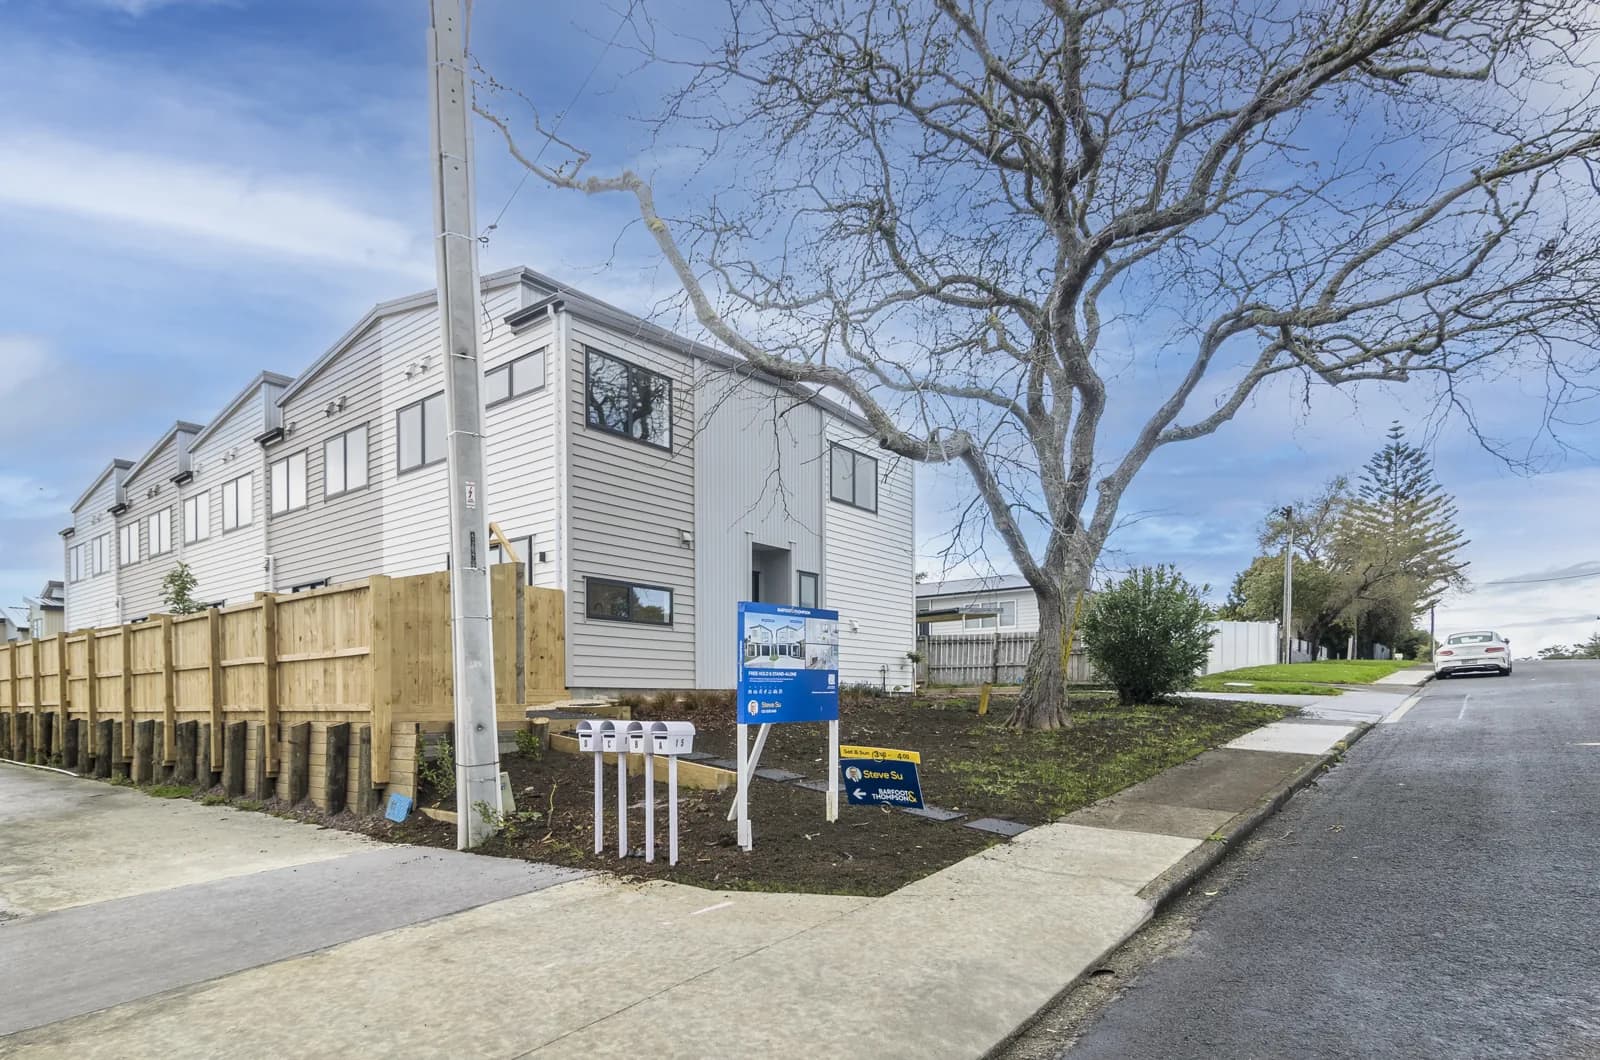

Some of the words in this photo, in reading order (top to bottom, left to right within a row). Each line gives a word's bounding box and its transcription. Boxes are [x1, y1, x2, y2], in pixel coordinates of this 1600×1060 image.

[863, 770, 890, 779] Steve
[890, 770, 904, 780] Su
[872, 793, 910, 802] THOMPSON
